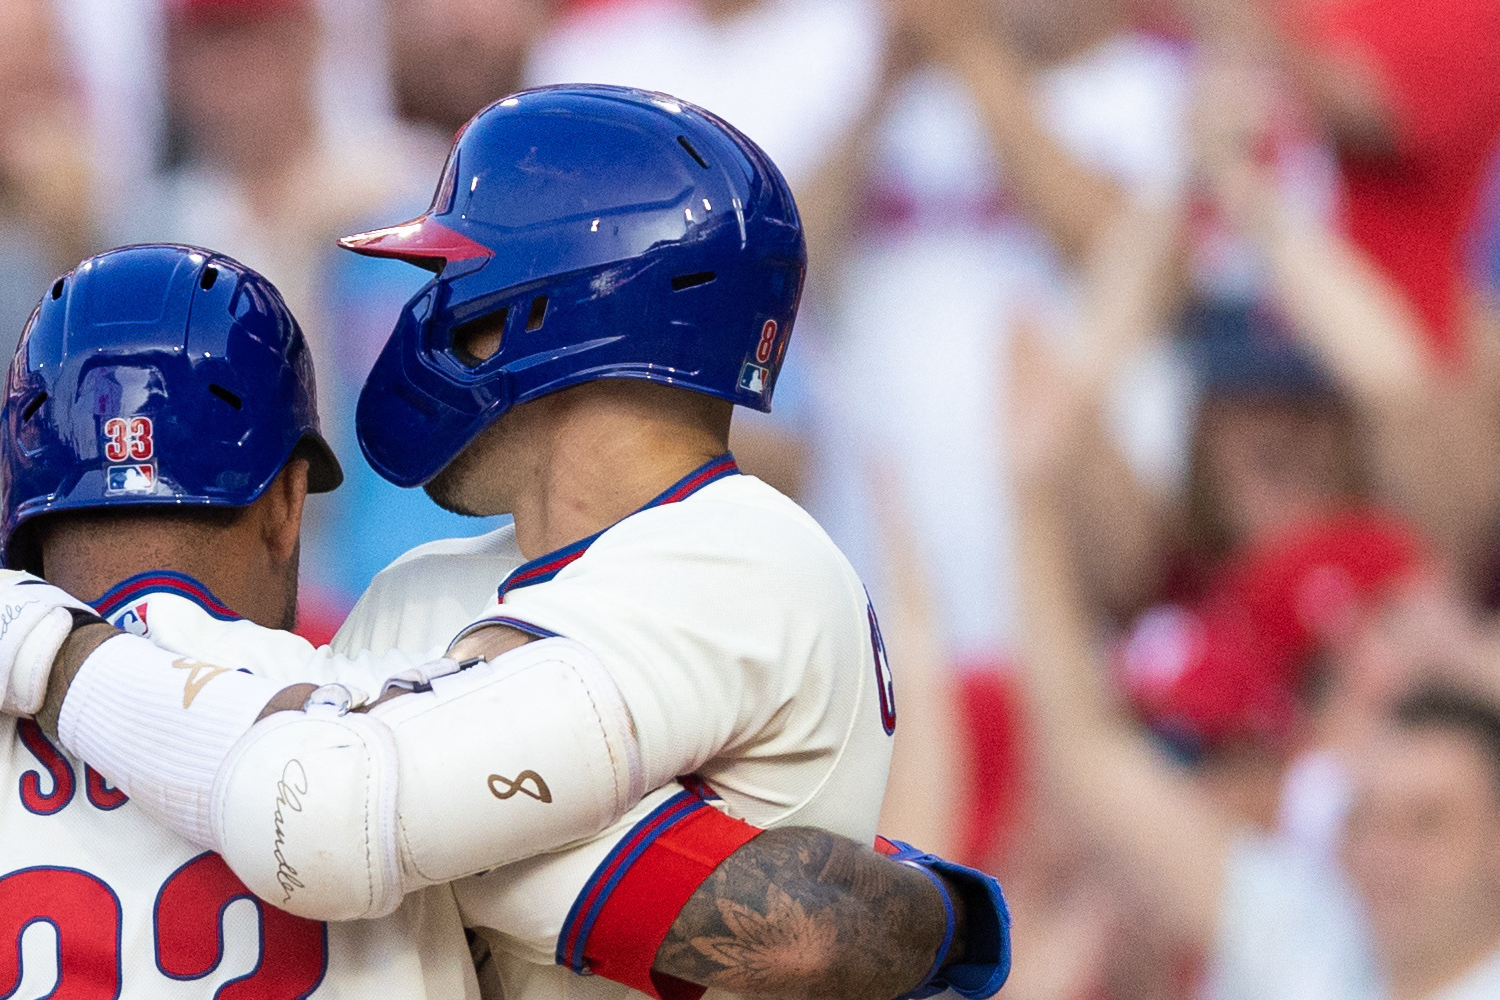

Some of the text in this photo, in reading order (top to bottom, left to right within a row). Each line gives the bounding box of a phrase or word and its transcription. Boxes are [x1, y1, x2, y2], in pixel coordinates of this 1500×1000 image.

[756, 320, 777, 363] 8
[104, 416, 154, 462] 33
[487, 769, 552, 803] 8
[274, 759, 308, 904] Chandler
